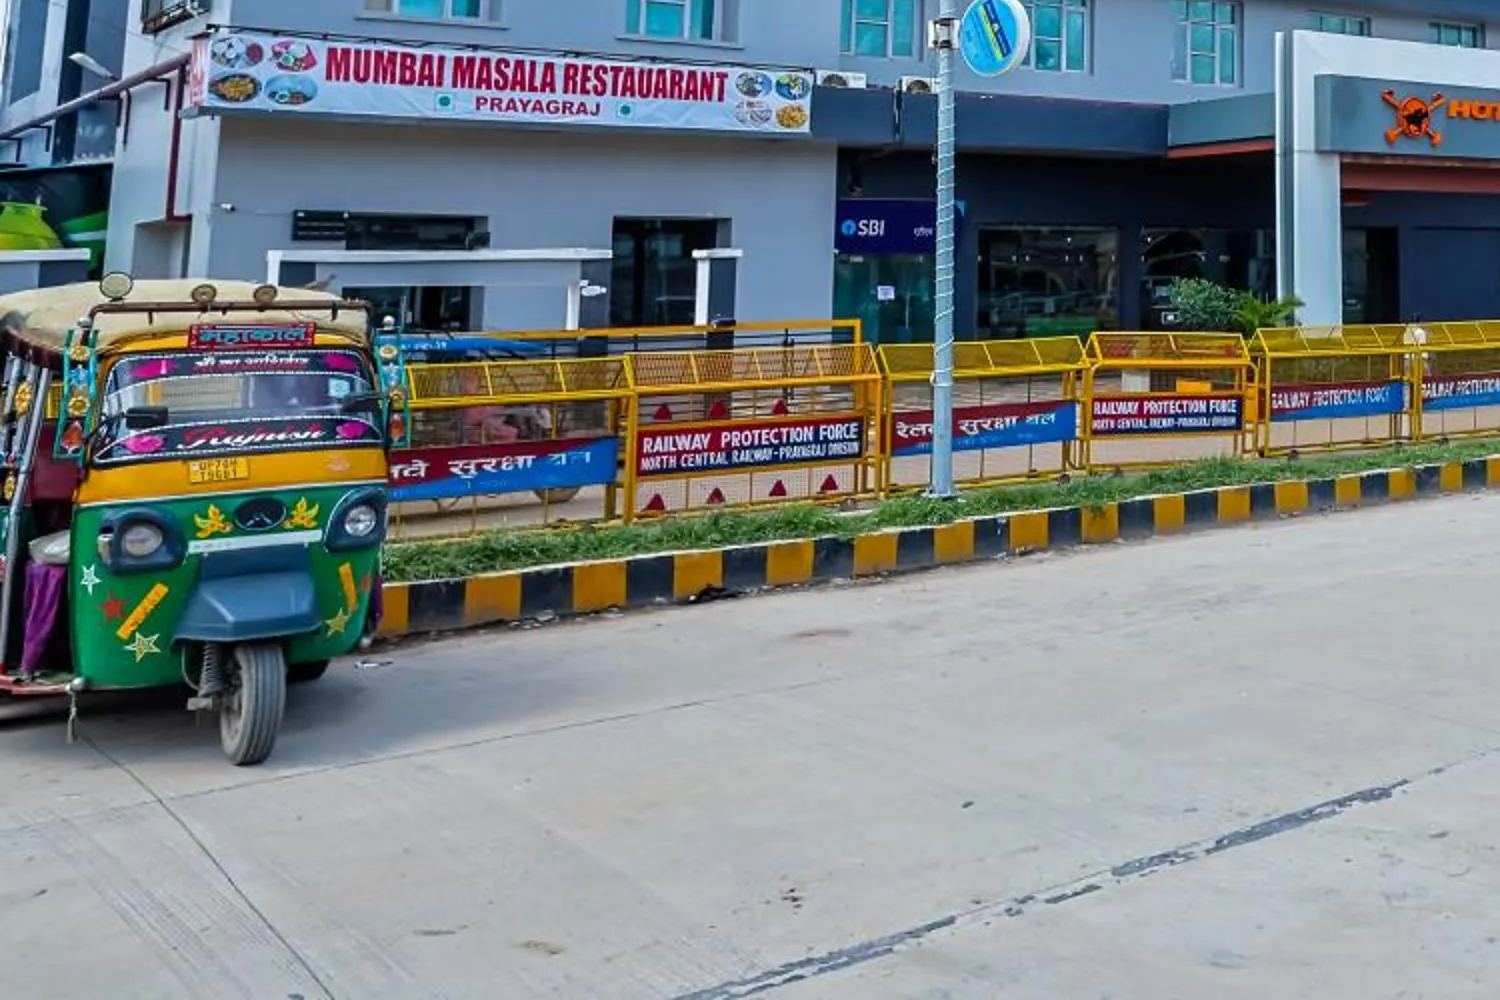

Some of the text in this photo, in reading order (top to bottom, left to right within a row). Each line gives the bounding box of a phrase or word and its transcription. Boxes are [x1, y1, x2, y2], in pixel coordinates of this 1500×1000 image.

[325, 45, 729, 102] MUMBAI MASALA RESTAUARANT
[474, 95, 601, 118] PRAYAGRAJ
[857, 219, 885, 236] SBI
[1093, 401, 1139, 415] RAILWAY
[1143, 400, 1207, 415] PROTECTION
[958, 415, 1020, 436] सुरक्षा
[643, 421, 859, 453] RAILWAY PROTECTION FORCE
[448, 454, 538, 480] सुरक्षा
[640, 453, 677, 471] NORTH
[681, 449, 729, 468] CENTRAL
